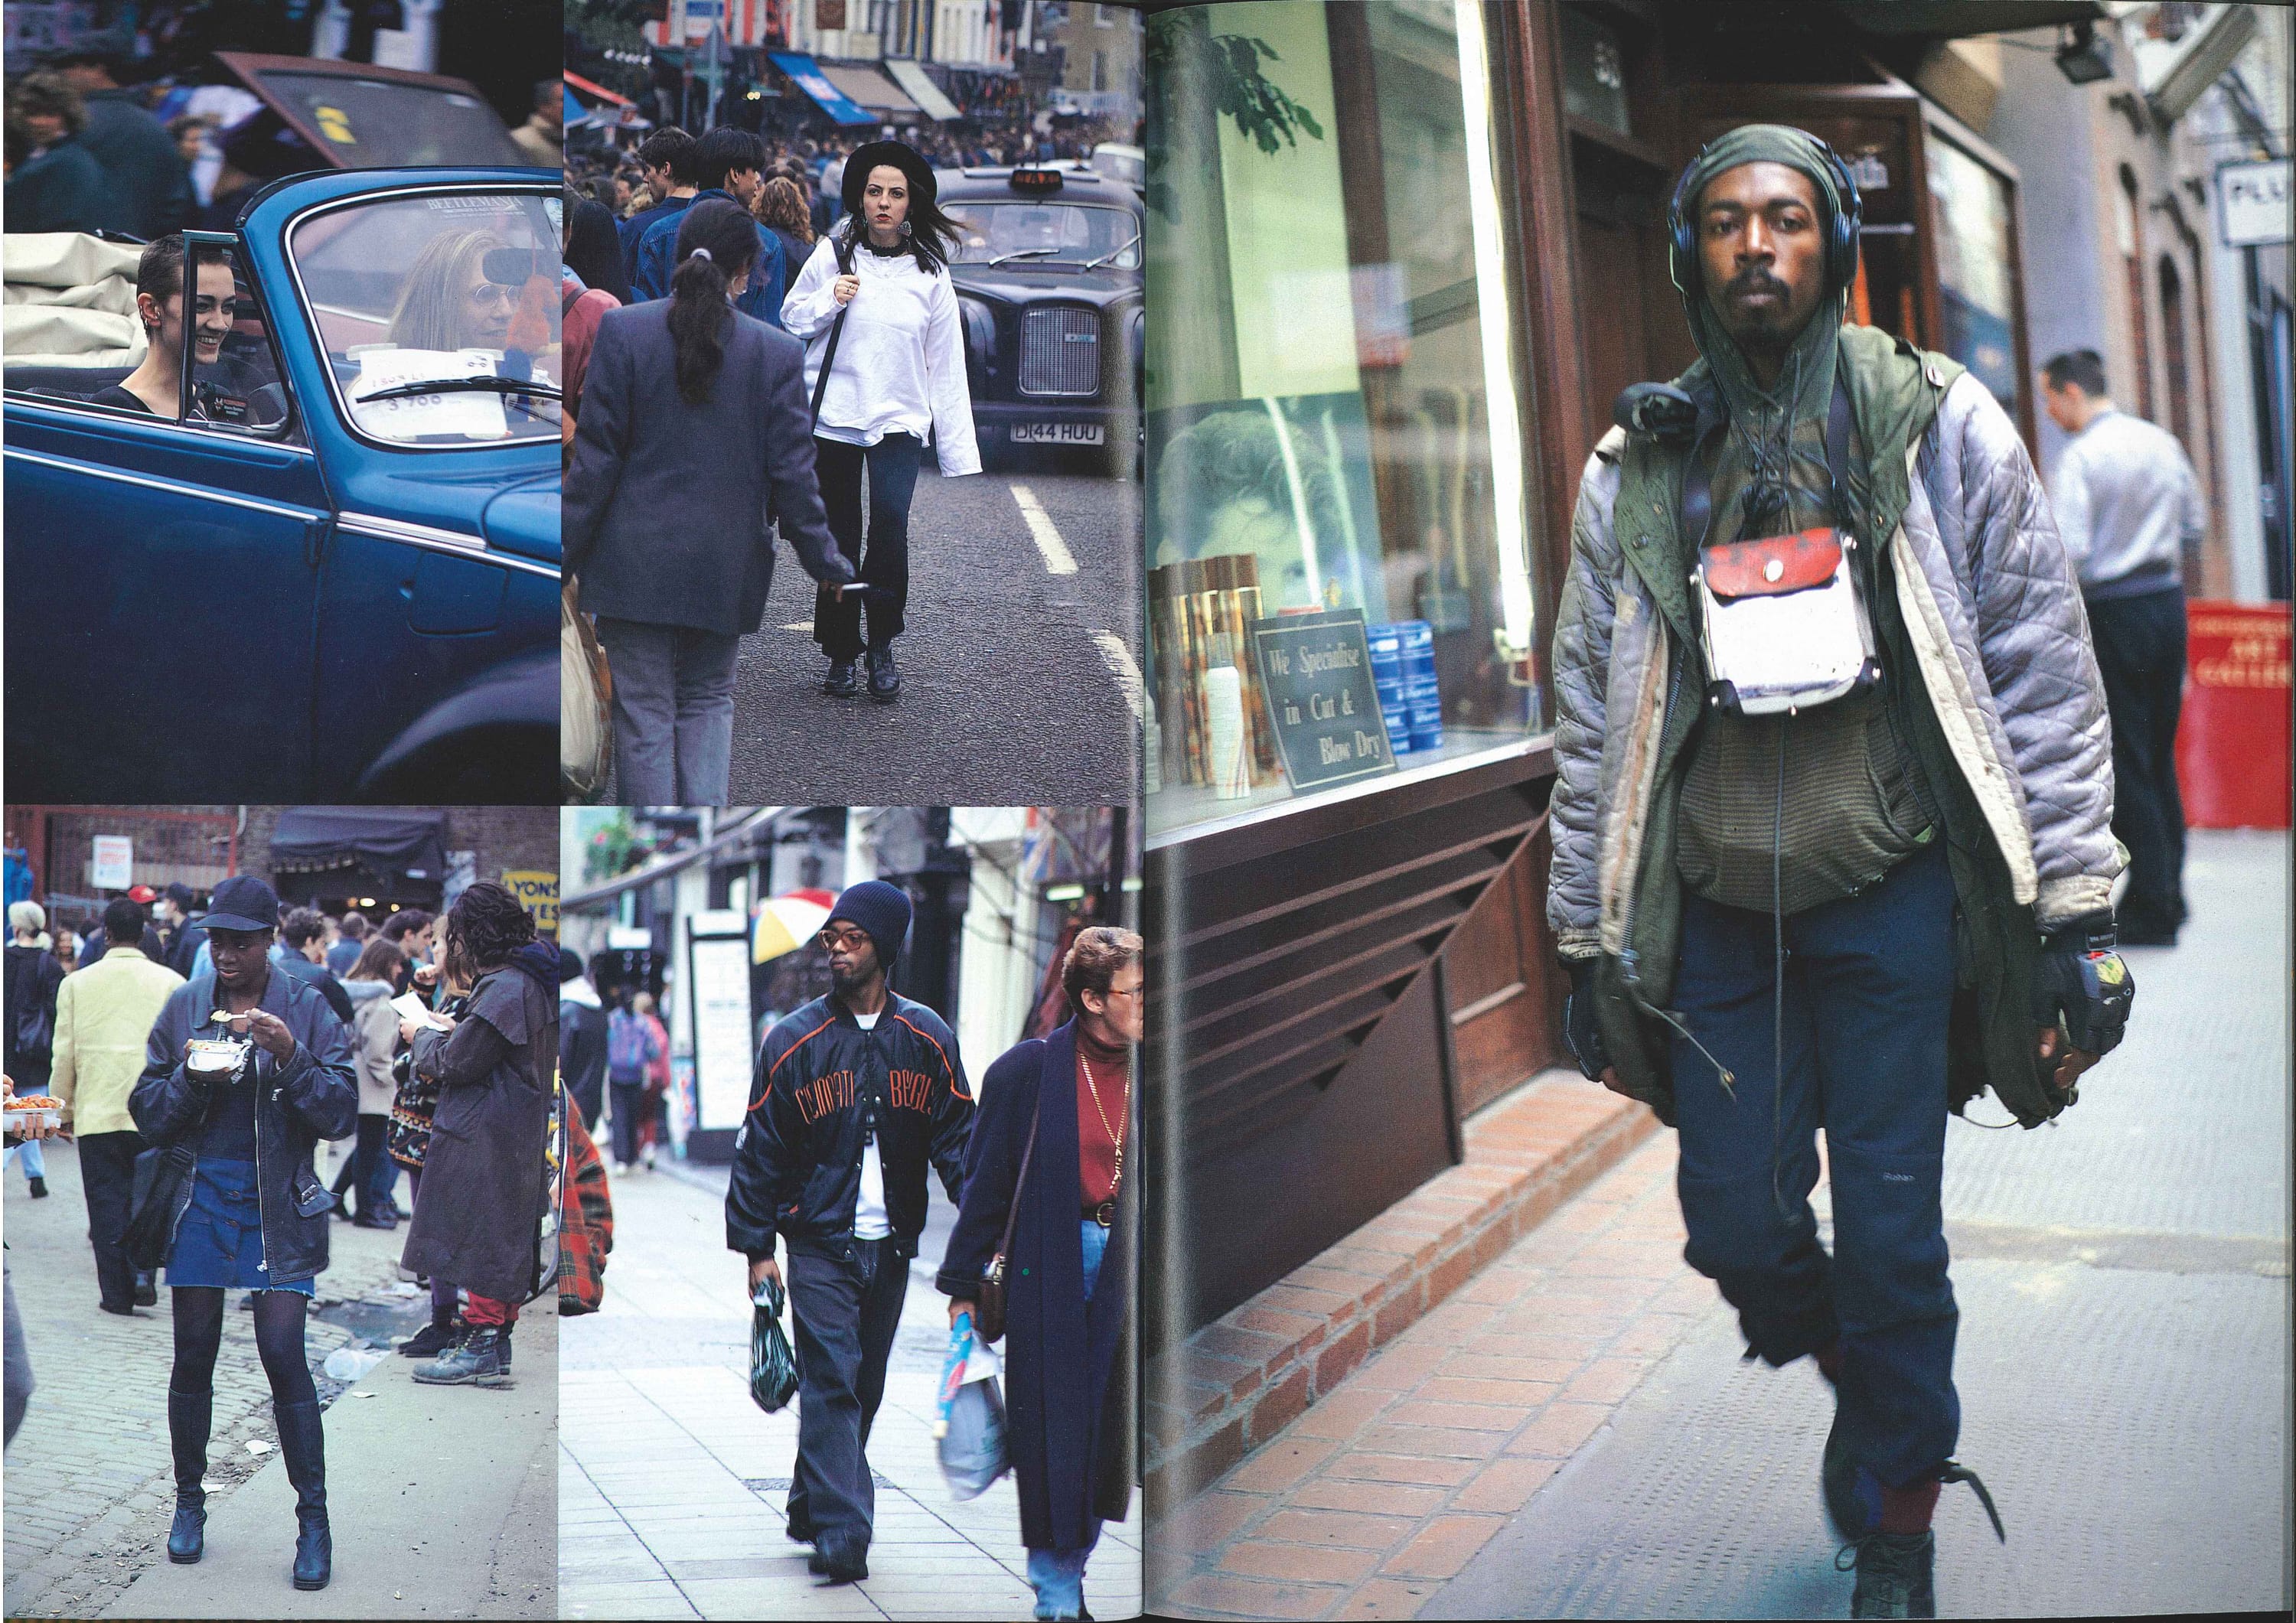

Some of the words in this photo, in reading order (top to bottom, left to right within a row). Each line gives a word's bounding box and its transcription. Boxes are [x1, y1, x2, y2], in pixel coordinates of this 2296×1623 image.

[1015, 424, 1056, 439] D144
[1061, 424, 1097, 441] HUU
[1269, 649, 1290, 676] We
[1283, 698, 1301, 725] in
[1310, 693, 1336, 721] Cut
[1342, 689, 1355, 715] &
[1319, 735, 1352, 765] Blow
[1354, 730, 1380, 759] Dry
